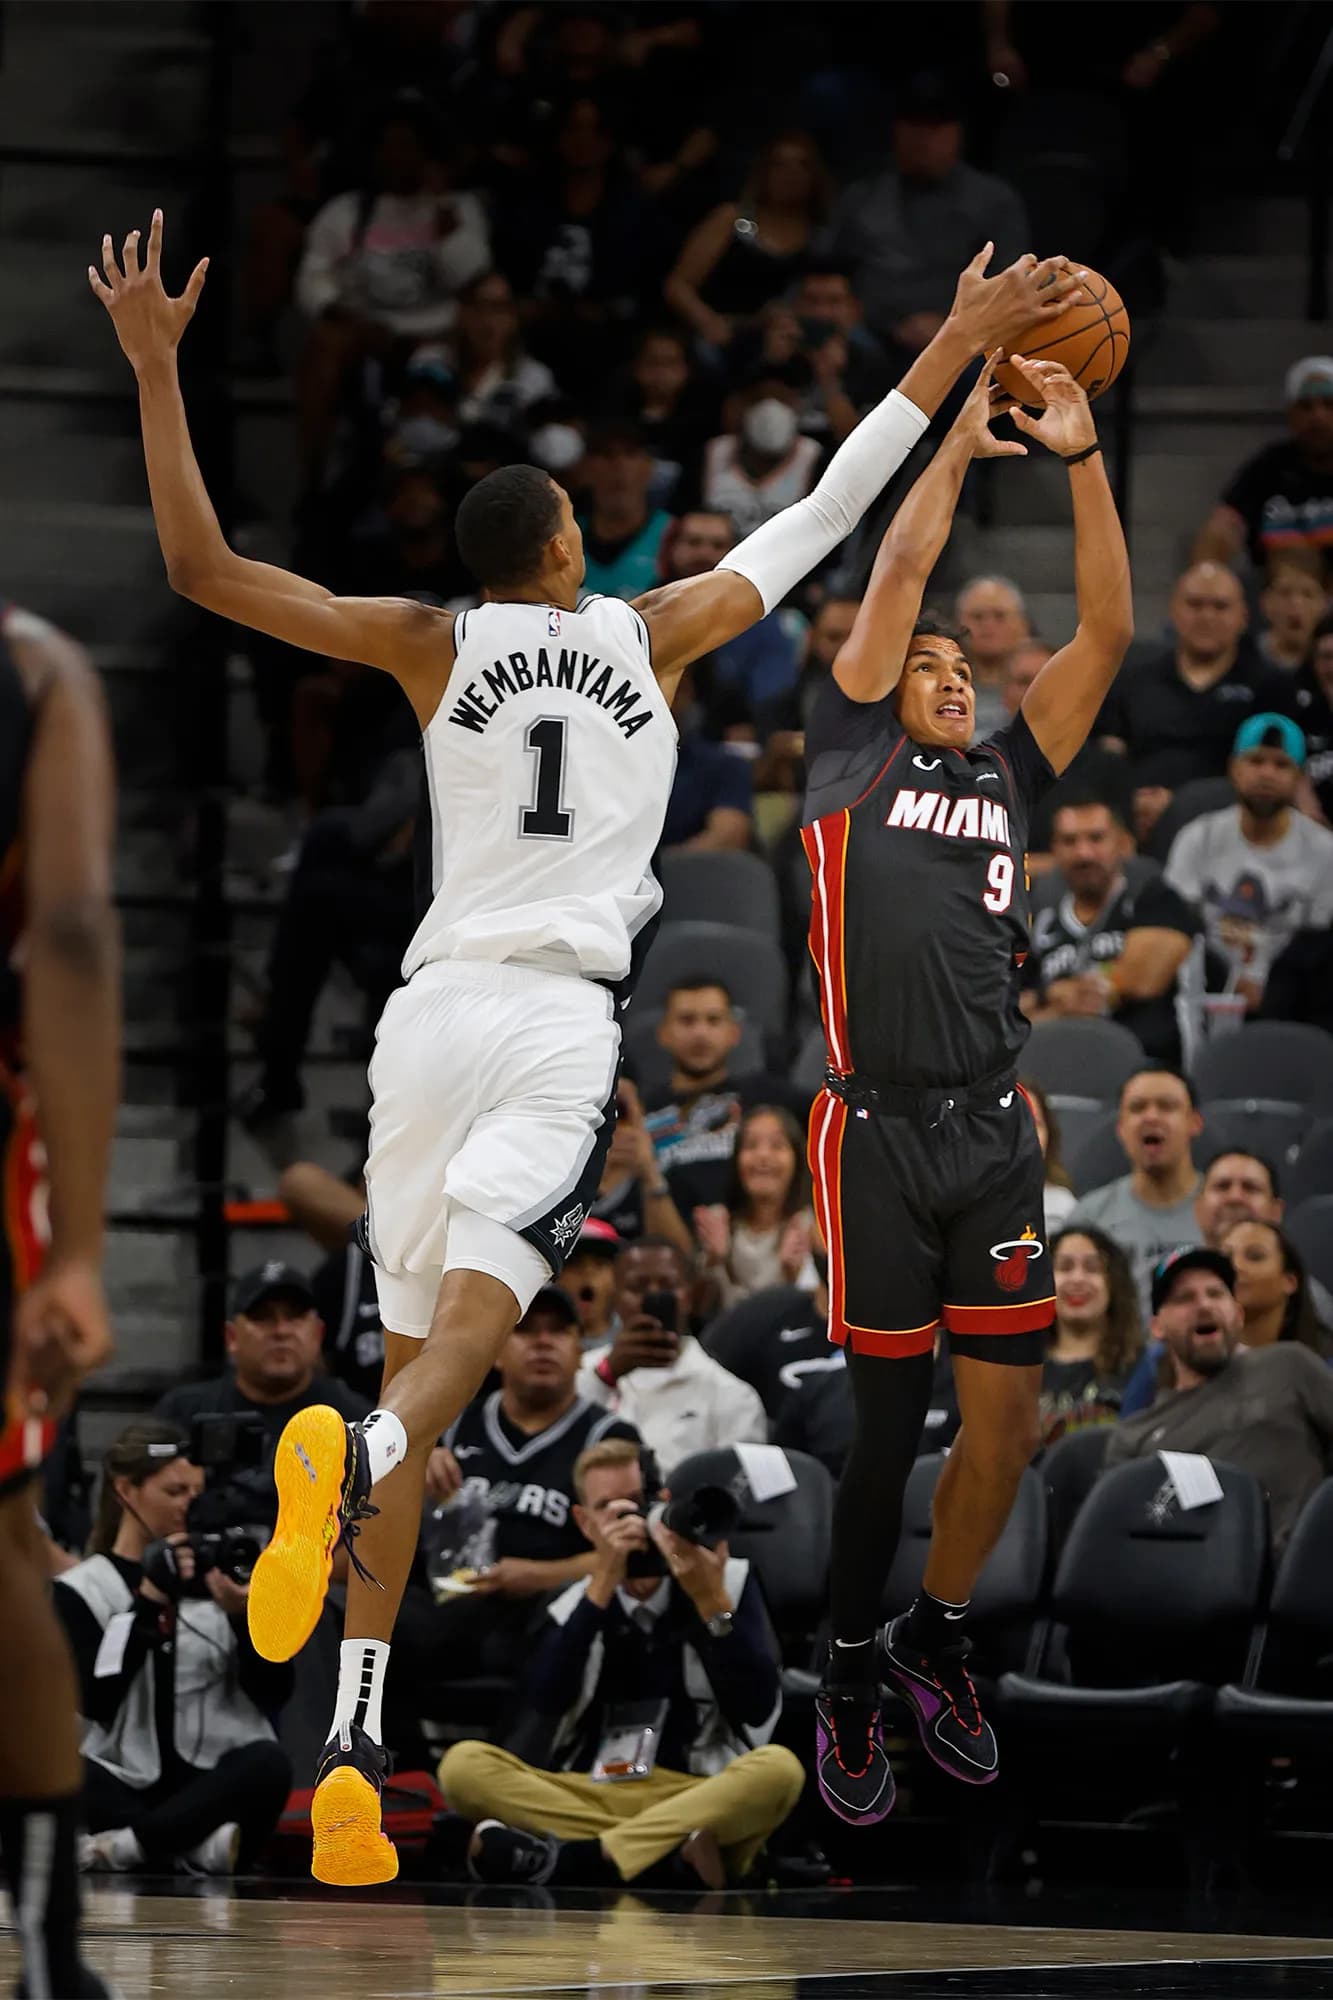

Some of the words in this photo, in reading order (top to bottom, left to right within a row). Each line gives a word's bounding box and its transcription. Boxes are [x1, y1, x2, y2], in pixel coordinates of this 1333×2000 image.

[448, 647, 654, 740] WEMBANYAMA
[518, 713, 576, 843] 1
[885, 789, 1012, 849] MIAMI
[981, 851, 1015, 915] 9
